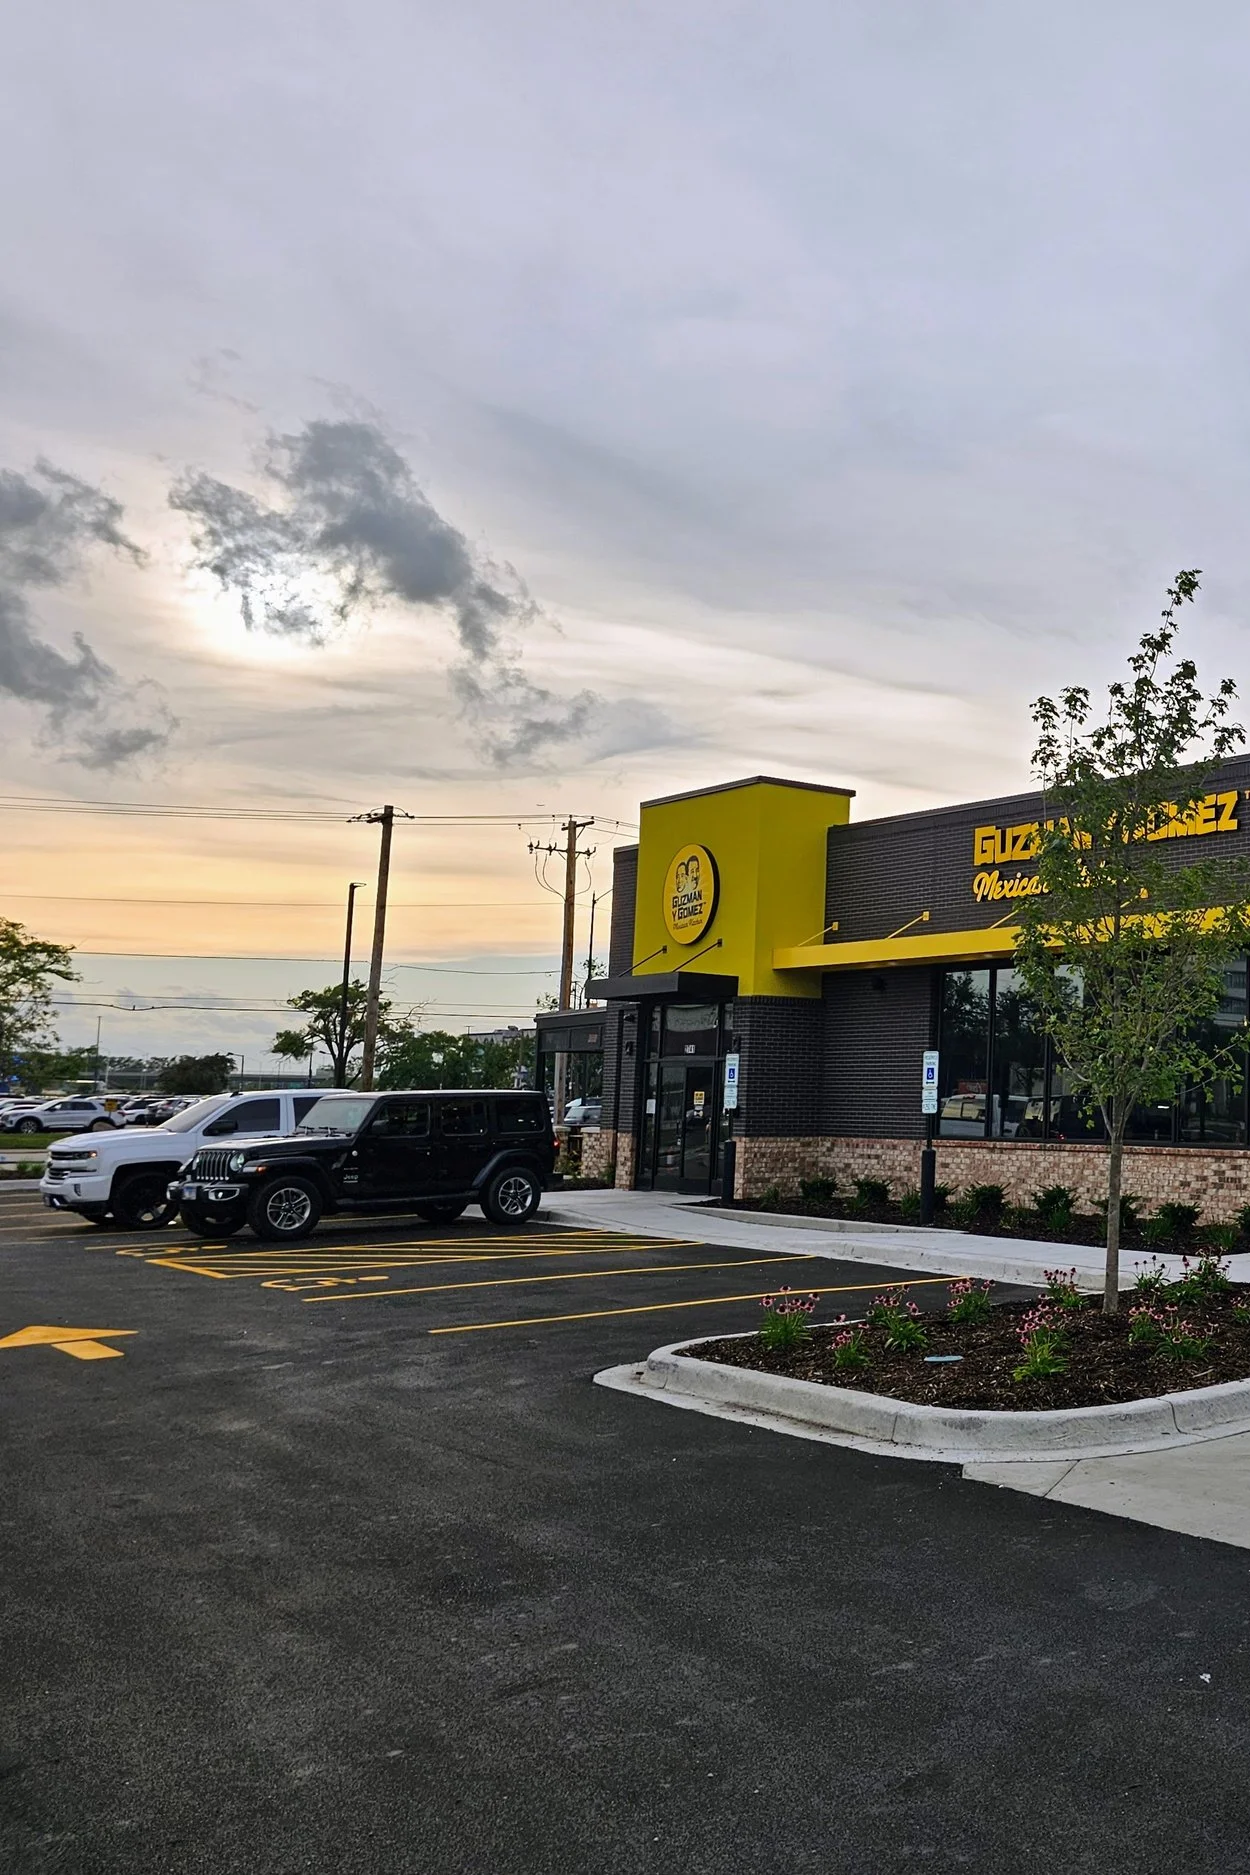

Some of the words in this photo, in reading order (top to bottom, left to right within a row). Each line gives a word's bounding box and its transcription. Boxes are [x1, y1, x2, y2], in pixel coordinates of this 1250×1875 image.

[1122, 790, 1238, 843] OMEZ
[673, 890, 702, 909] GUZMAN
[672, 909, 677, 922] Y
